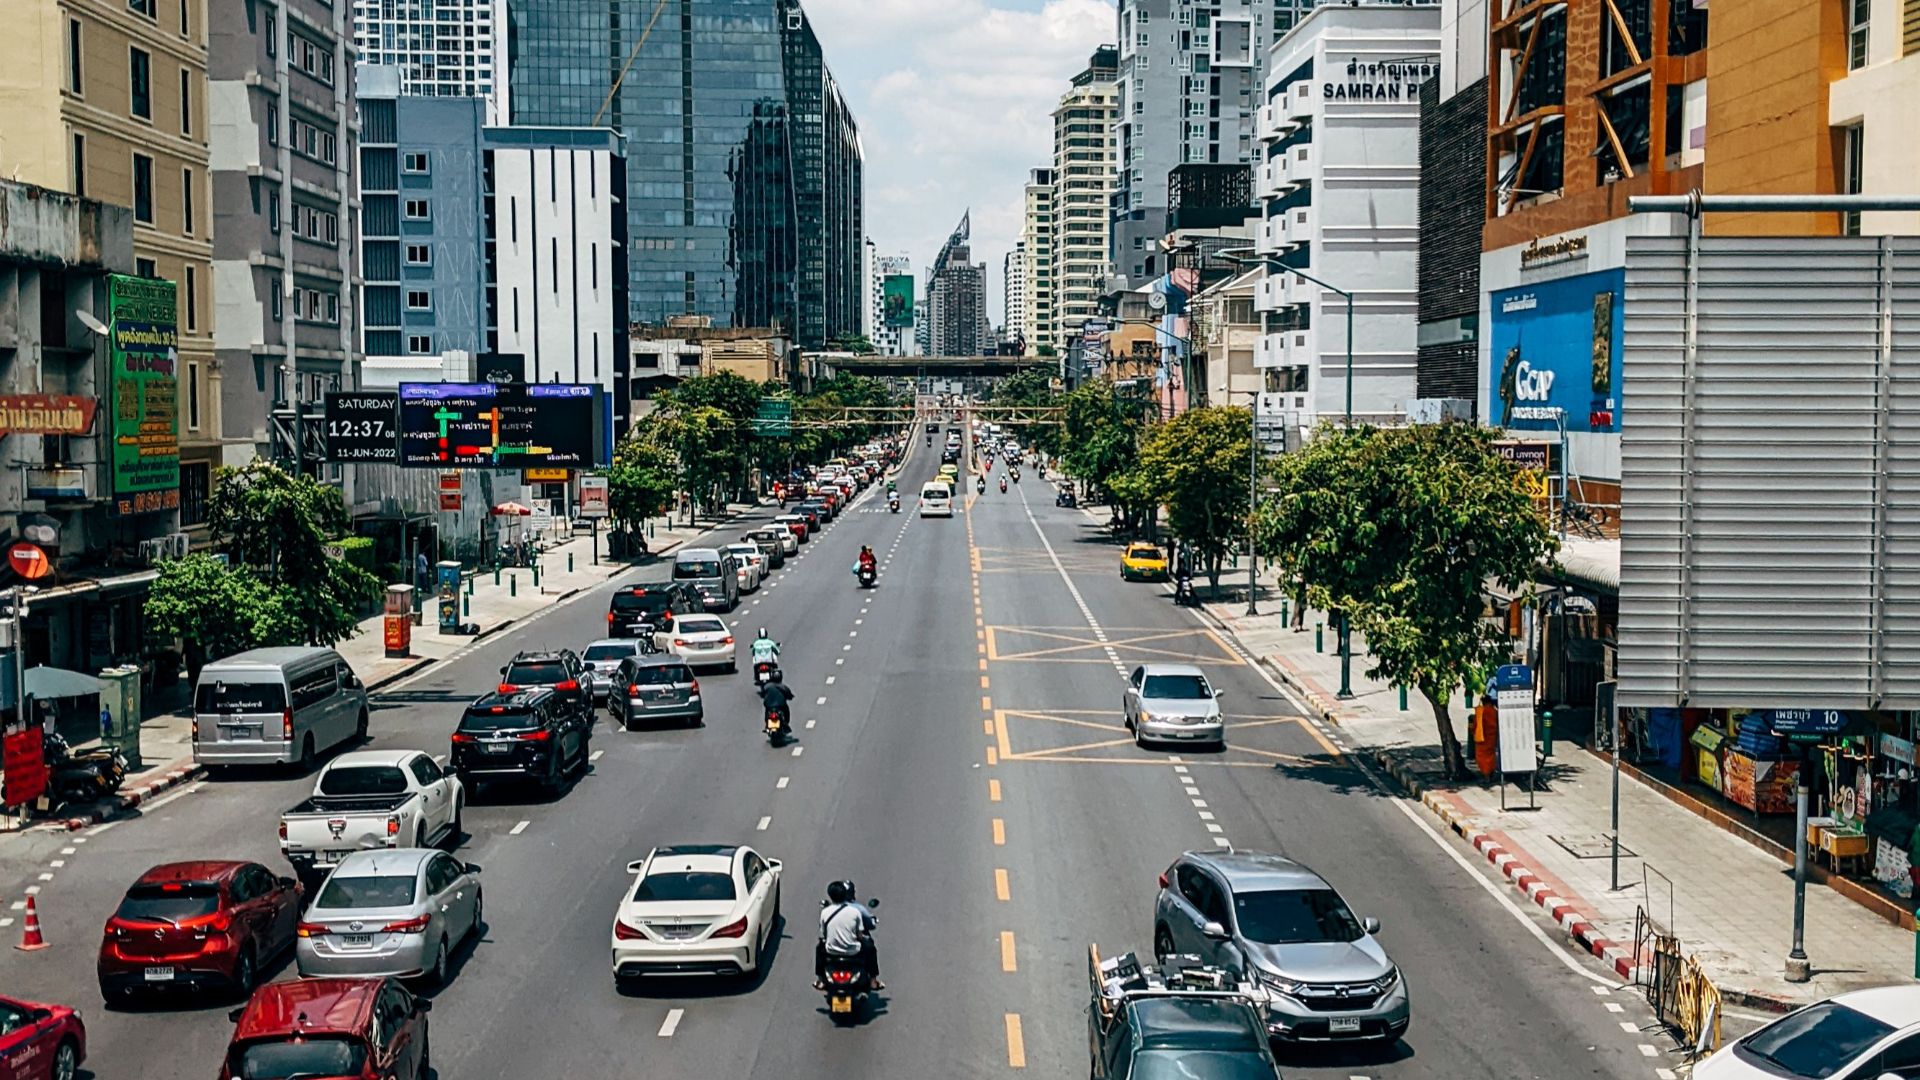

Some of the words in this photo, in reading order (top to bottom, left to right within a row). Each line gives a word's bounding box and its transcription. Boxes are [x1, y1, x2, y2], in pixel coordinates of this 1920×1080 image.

[1323, 82, 1400, 99] SAMRAN
[338, 399, 395, 409] SATURDAY
[329, 421, 384, 437] 12:37
[385, 430, 396, 438] 08
[337, 448, 396, 458] 11-JUN-2022
[1824, 710, 1839, 725] 10
